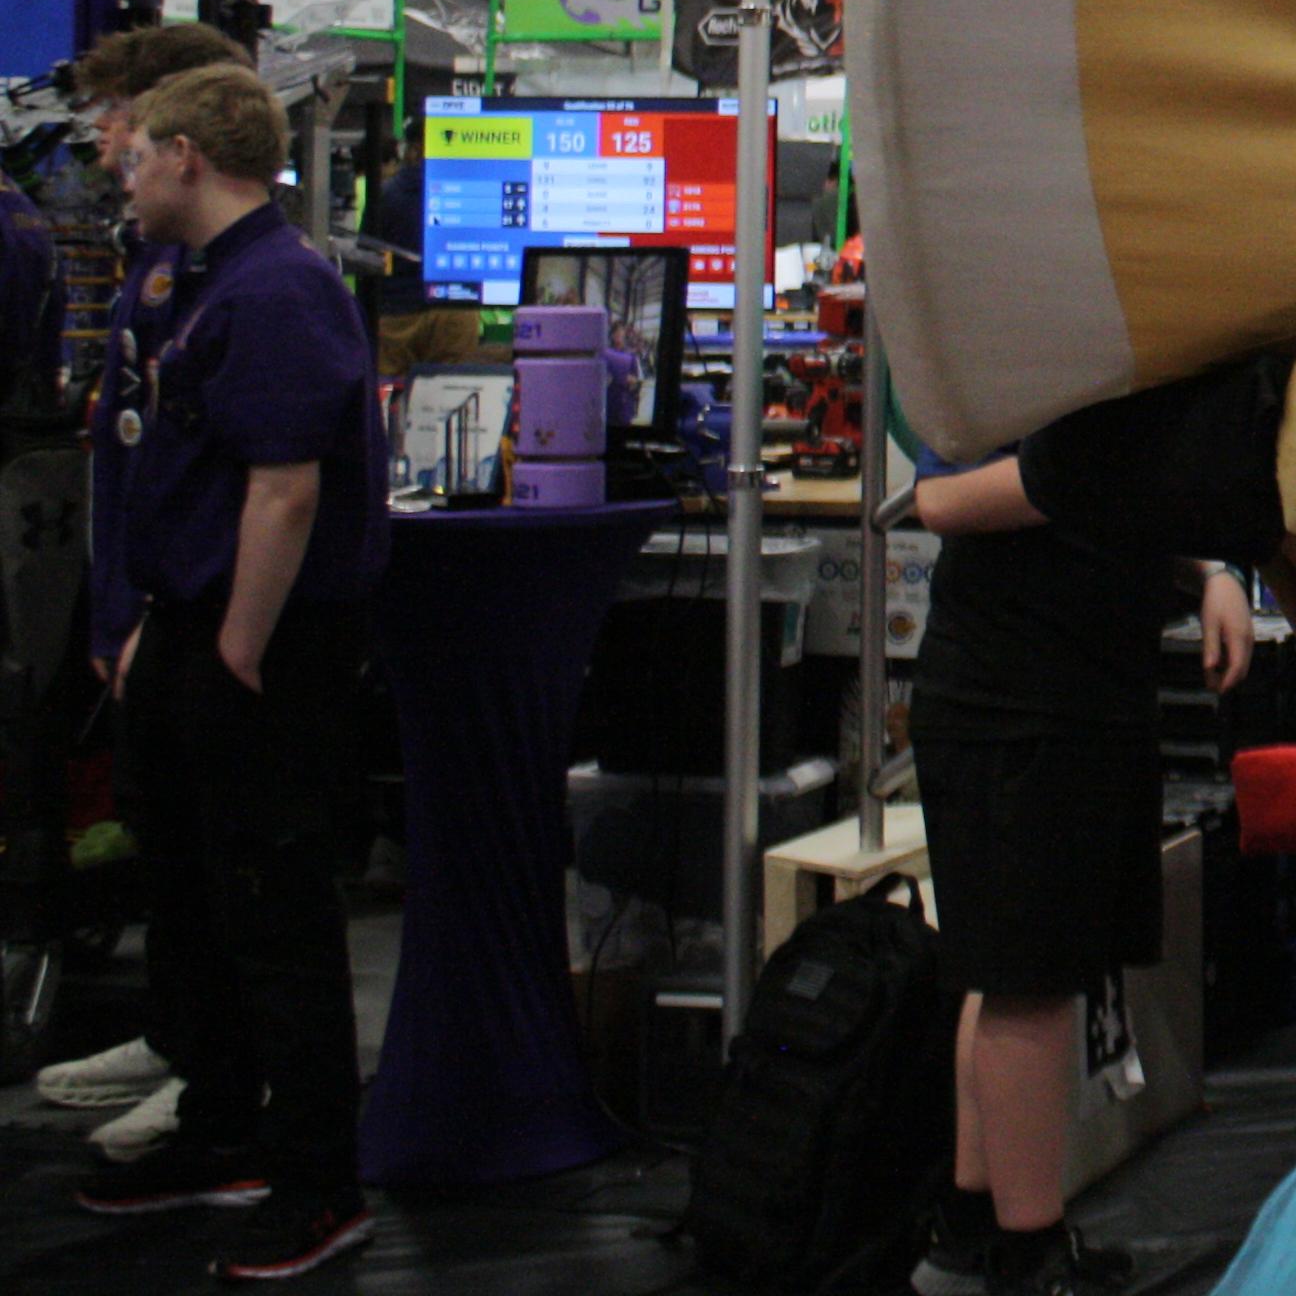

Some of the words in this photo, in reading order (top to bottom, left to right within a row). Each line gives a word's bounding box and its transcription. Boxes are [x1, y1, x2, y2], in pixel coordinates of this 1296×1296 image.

[461, 130, 522, 145] WINNER
[546, 133, 586, 153] 150
[611, 132, 652, 153] 125
